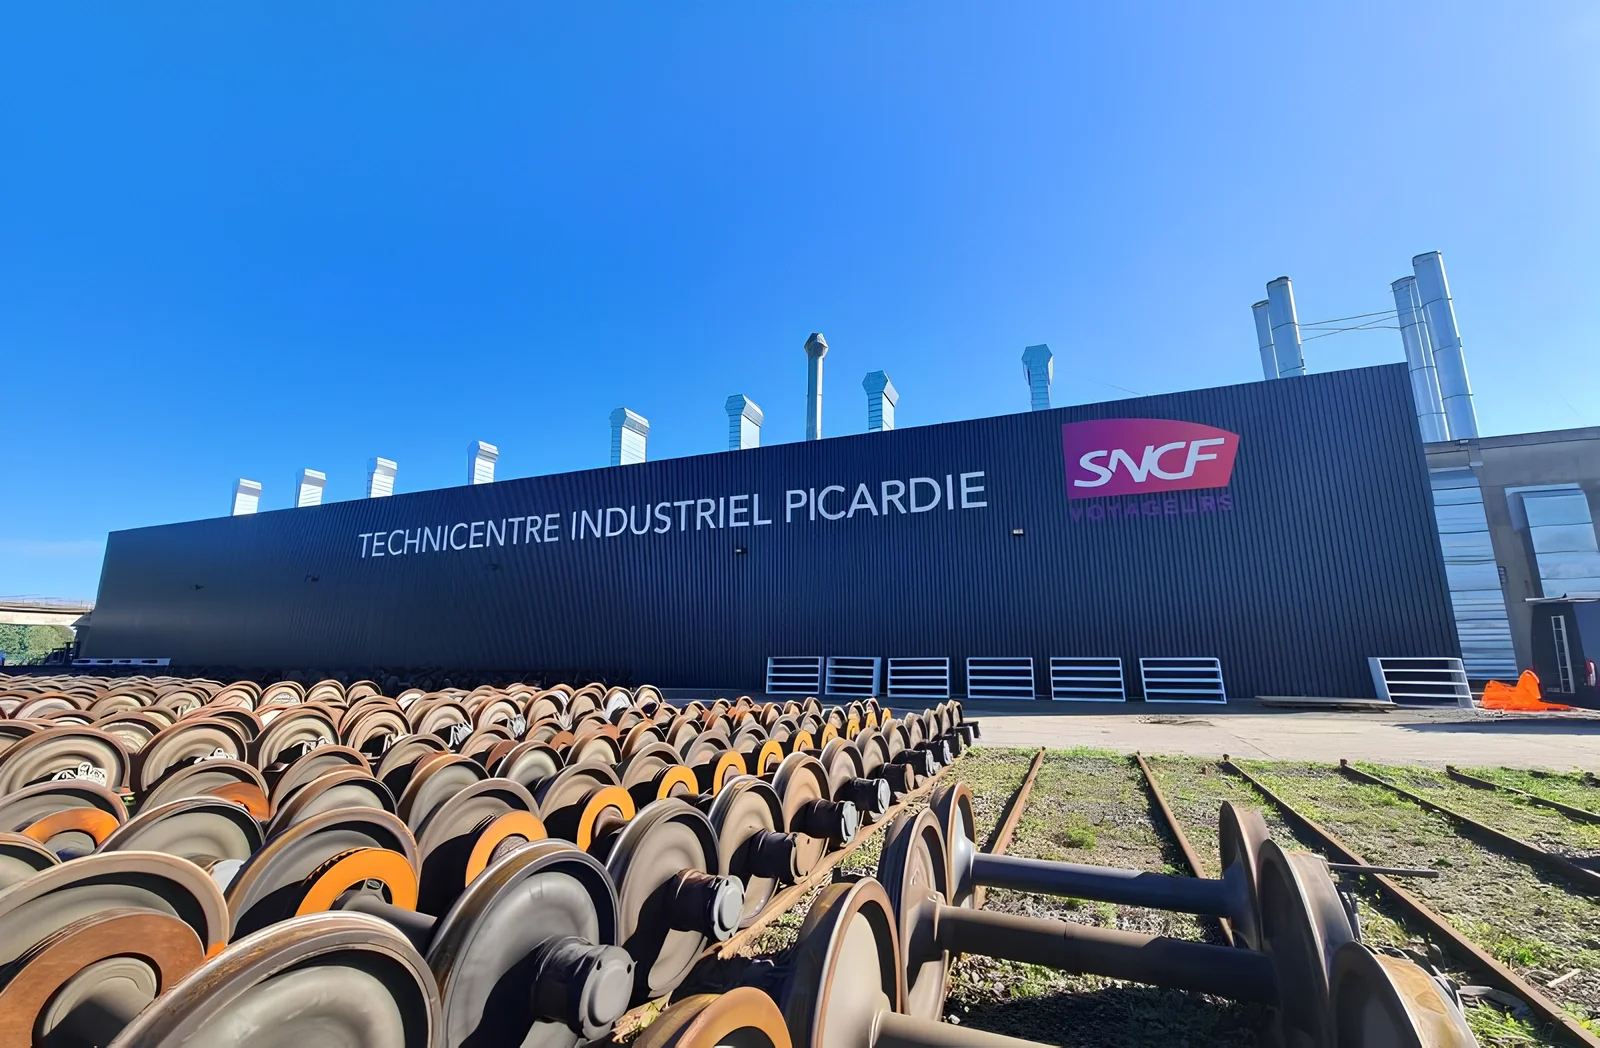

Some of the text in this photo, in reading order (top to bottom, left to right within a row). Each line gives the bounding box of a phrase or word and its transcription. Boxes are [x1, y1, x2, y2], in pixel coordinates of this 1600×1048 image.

[1073, 437, 1225, 488] SNCF
[358, 470, 989, 559] TECHNICENTRE INDUSTRIEL PICARDIE
[1069, 493, 1234, 522] VOYAGEURS
